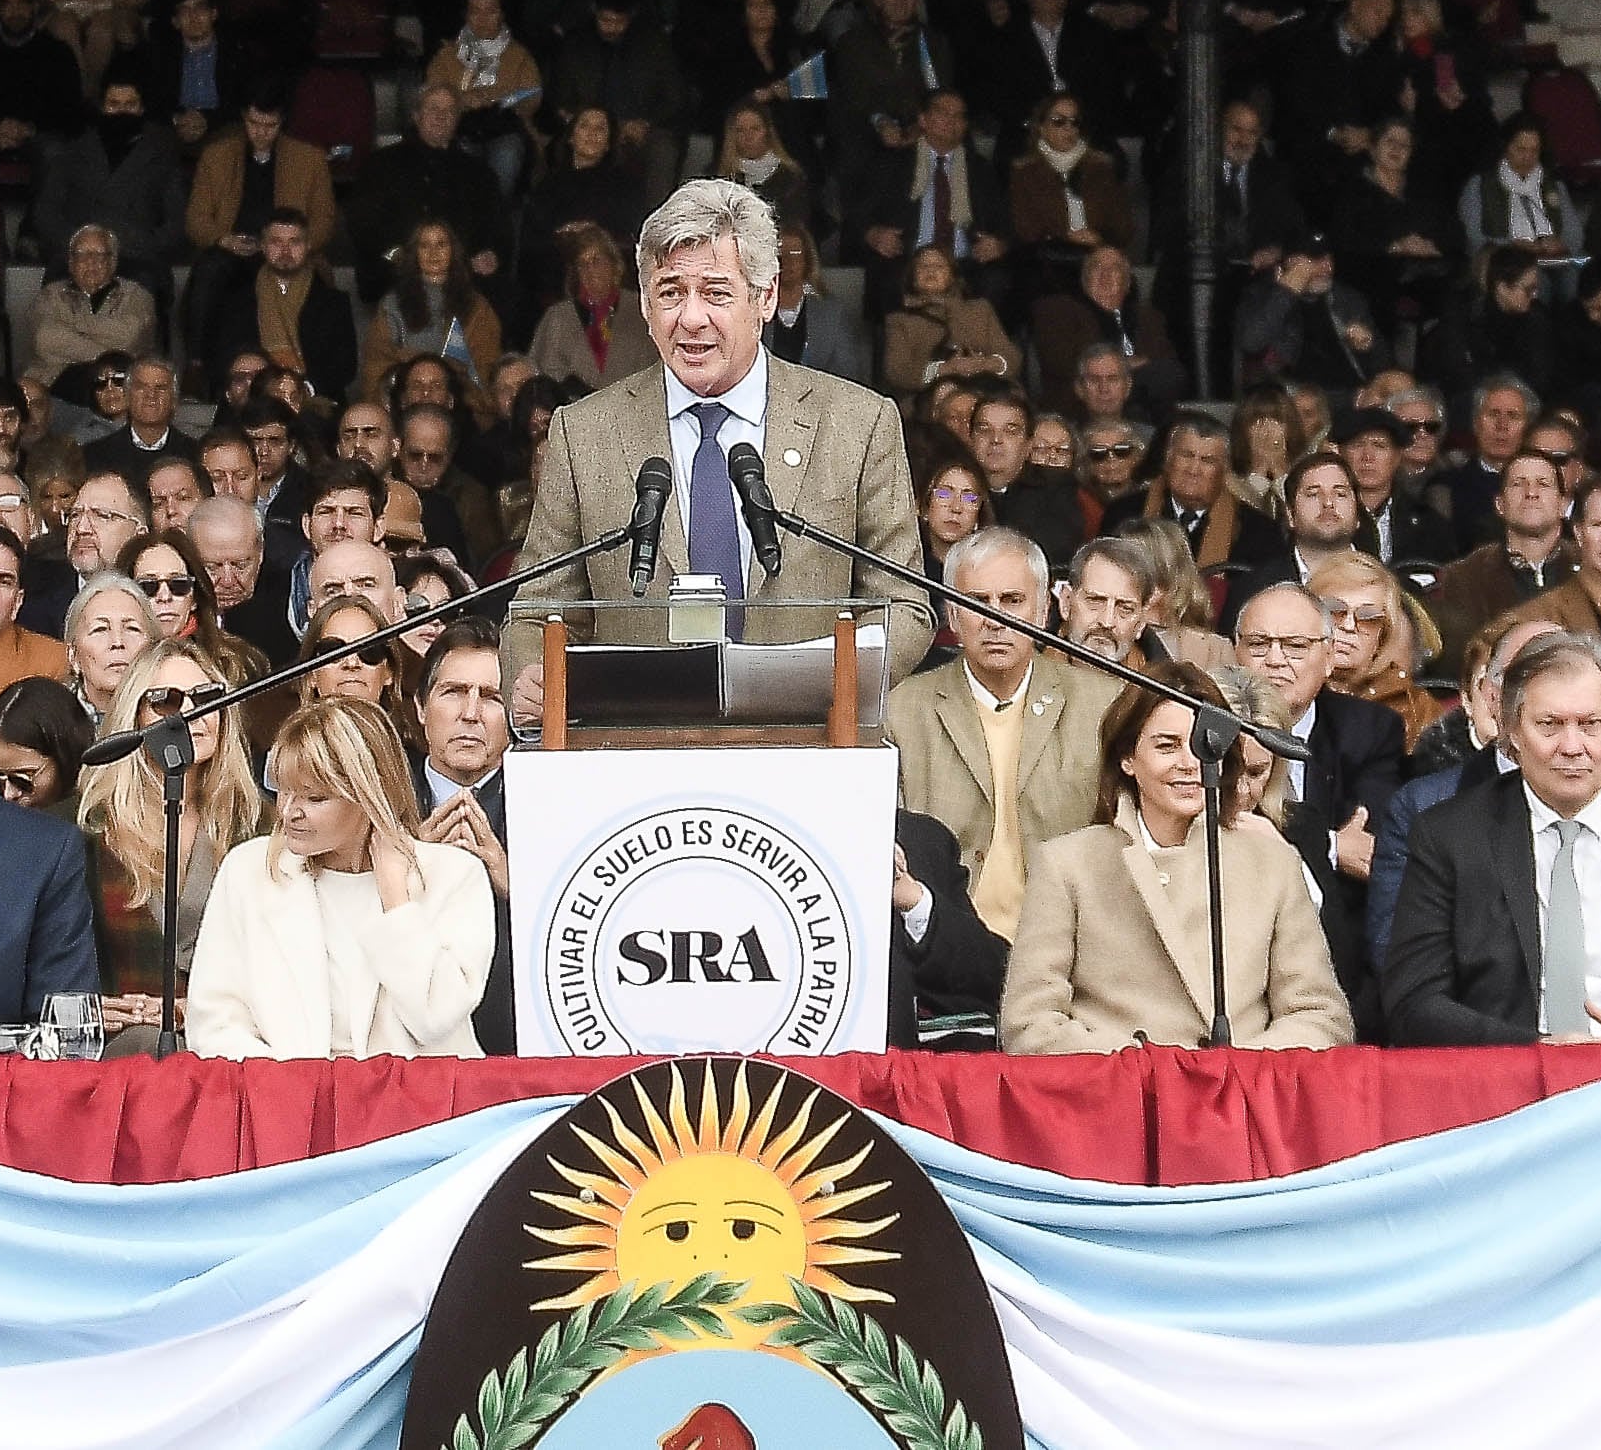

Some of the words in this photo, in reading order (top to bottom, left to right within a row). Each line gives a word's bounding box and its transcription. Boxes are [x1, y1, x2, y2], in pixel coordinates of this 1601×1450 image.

[594, 826, 672, 886] SUELO
[682, 821, 712, 845] ES
[723, 824, 807, 892] SERVIR
[571, 893, 603, 920] EL
[797, 894, 821, 914] A
[808, 917, 835, 951] LA
[617, 926, 780, 986] SRA
[561, 927, 606, 1050] CULTIVAR
[788, 960, 836, 1048] PATRIA
